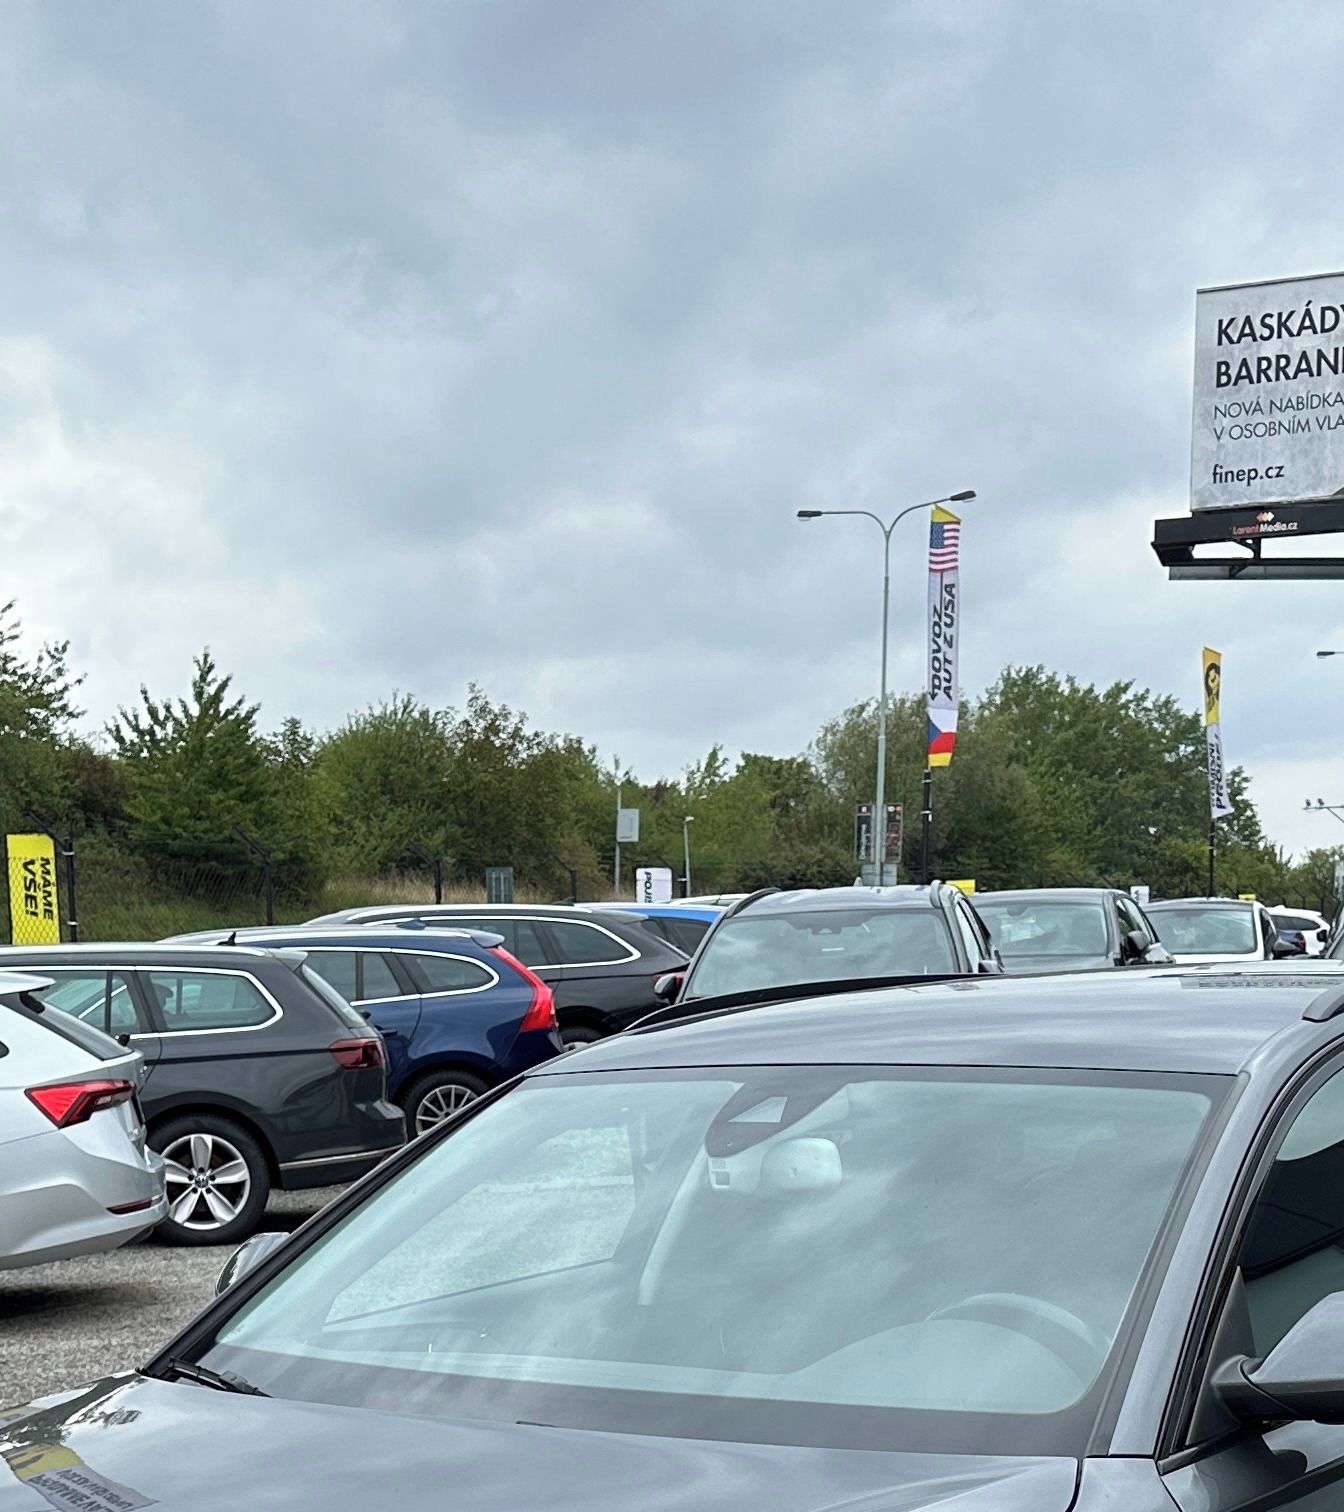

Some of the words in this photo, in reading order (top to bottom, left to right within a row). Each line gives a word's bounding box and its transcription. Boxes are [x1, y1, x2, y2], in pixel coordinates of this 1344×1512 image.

[1214, 396, 1264, 420] NOVÁ
[1269, 390, 1344, 414] NABÍDKA
[1214, 427, 1224, 441] V
[1228, 415, 1311, 441] OSOBNÍM
[1212, 463, 1285, 486] finep.cz
[943, 583, 956, 630] USA
[932, 604, 942, 691] DOVOZ
[943, 632, 954, 649] Z
[942, 652, 953, 701] AUT
[22, 859, 41, 918] VŠE!
[40, 856, 56, 920] MÁME
